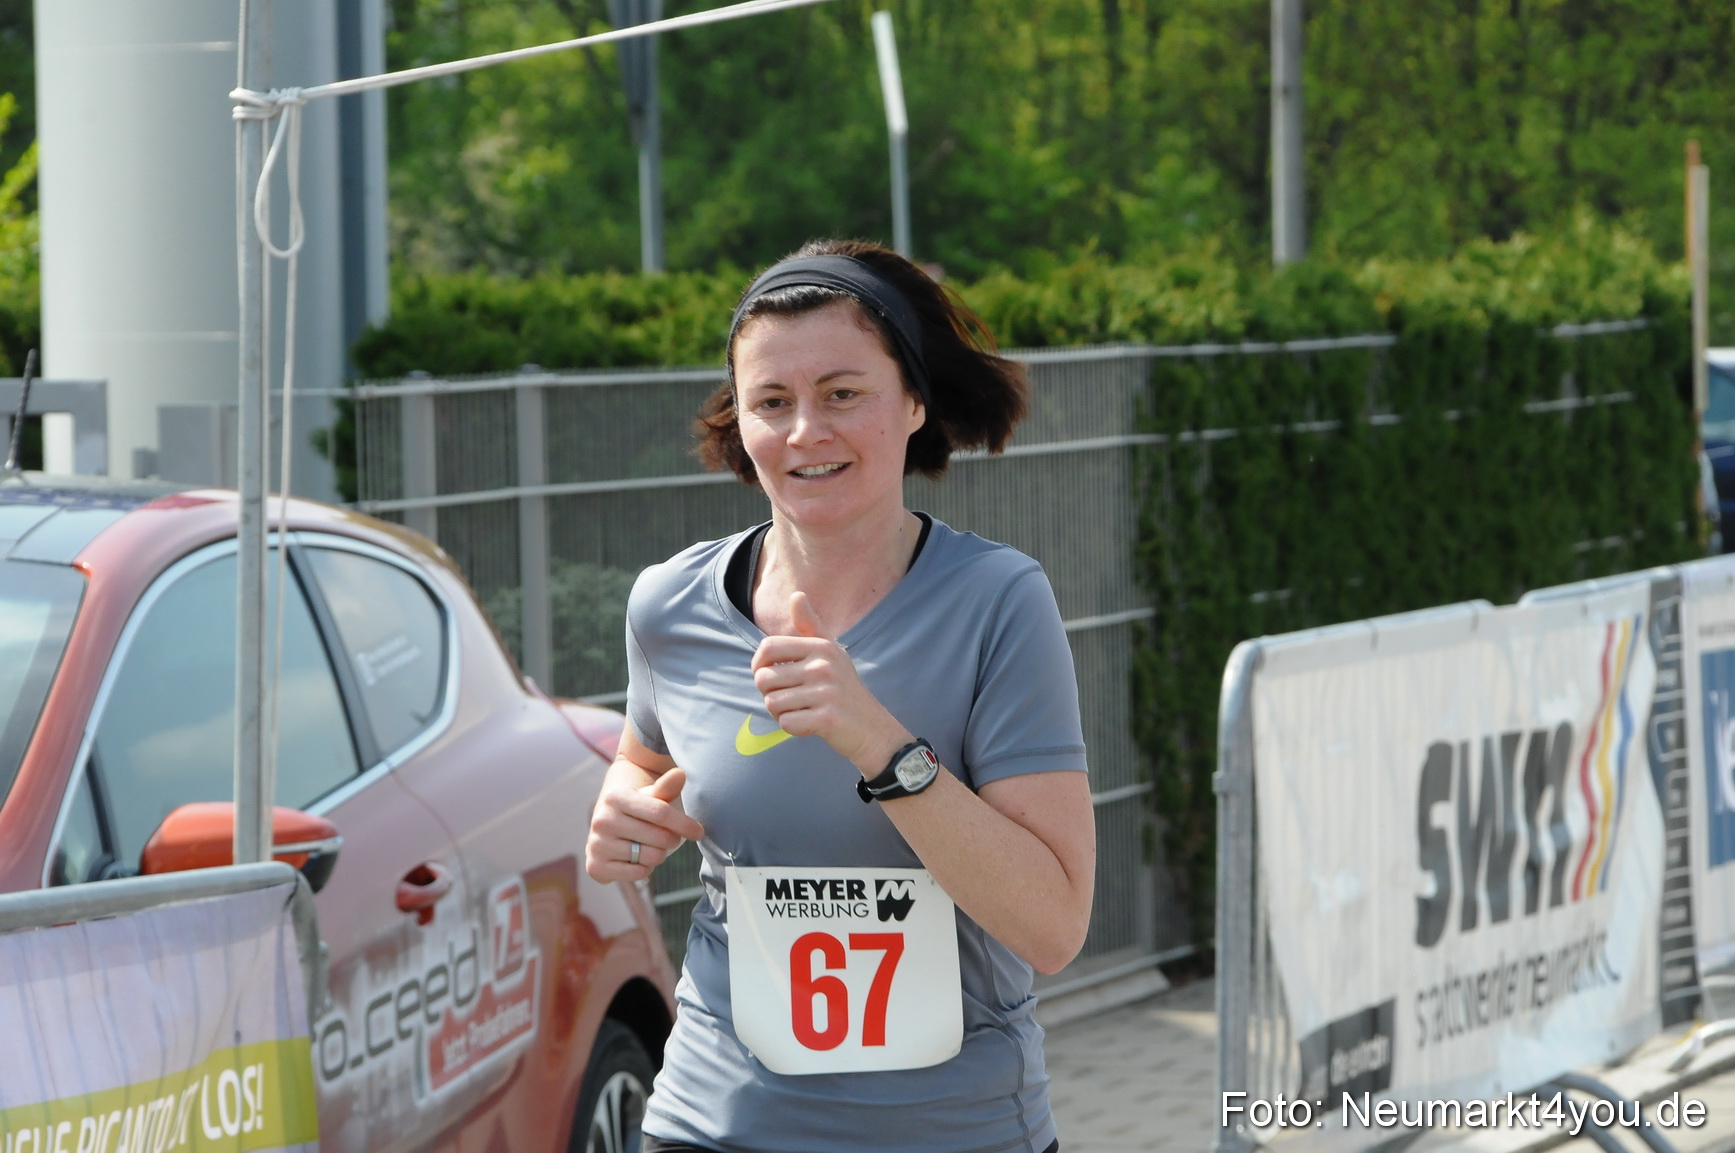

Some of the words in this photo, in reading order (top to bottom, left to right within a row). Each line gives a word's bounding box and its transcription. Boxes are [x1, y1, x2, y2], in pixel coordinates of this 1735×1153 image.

[765, 879, 868, 900] MEYER
[766, 902, 870, 919] WERBUNG
[789, 931, 905, 1052] 67
[201, 1063, 263, 1140] LOS!
